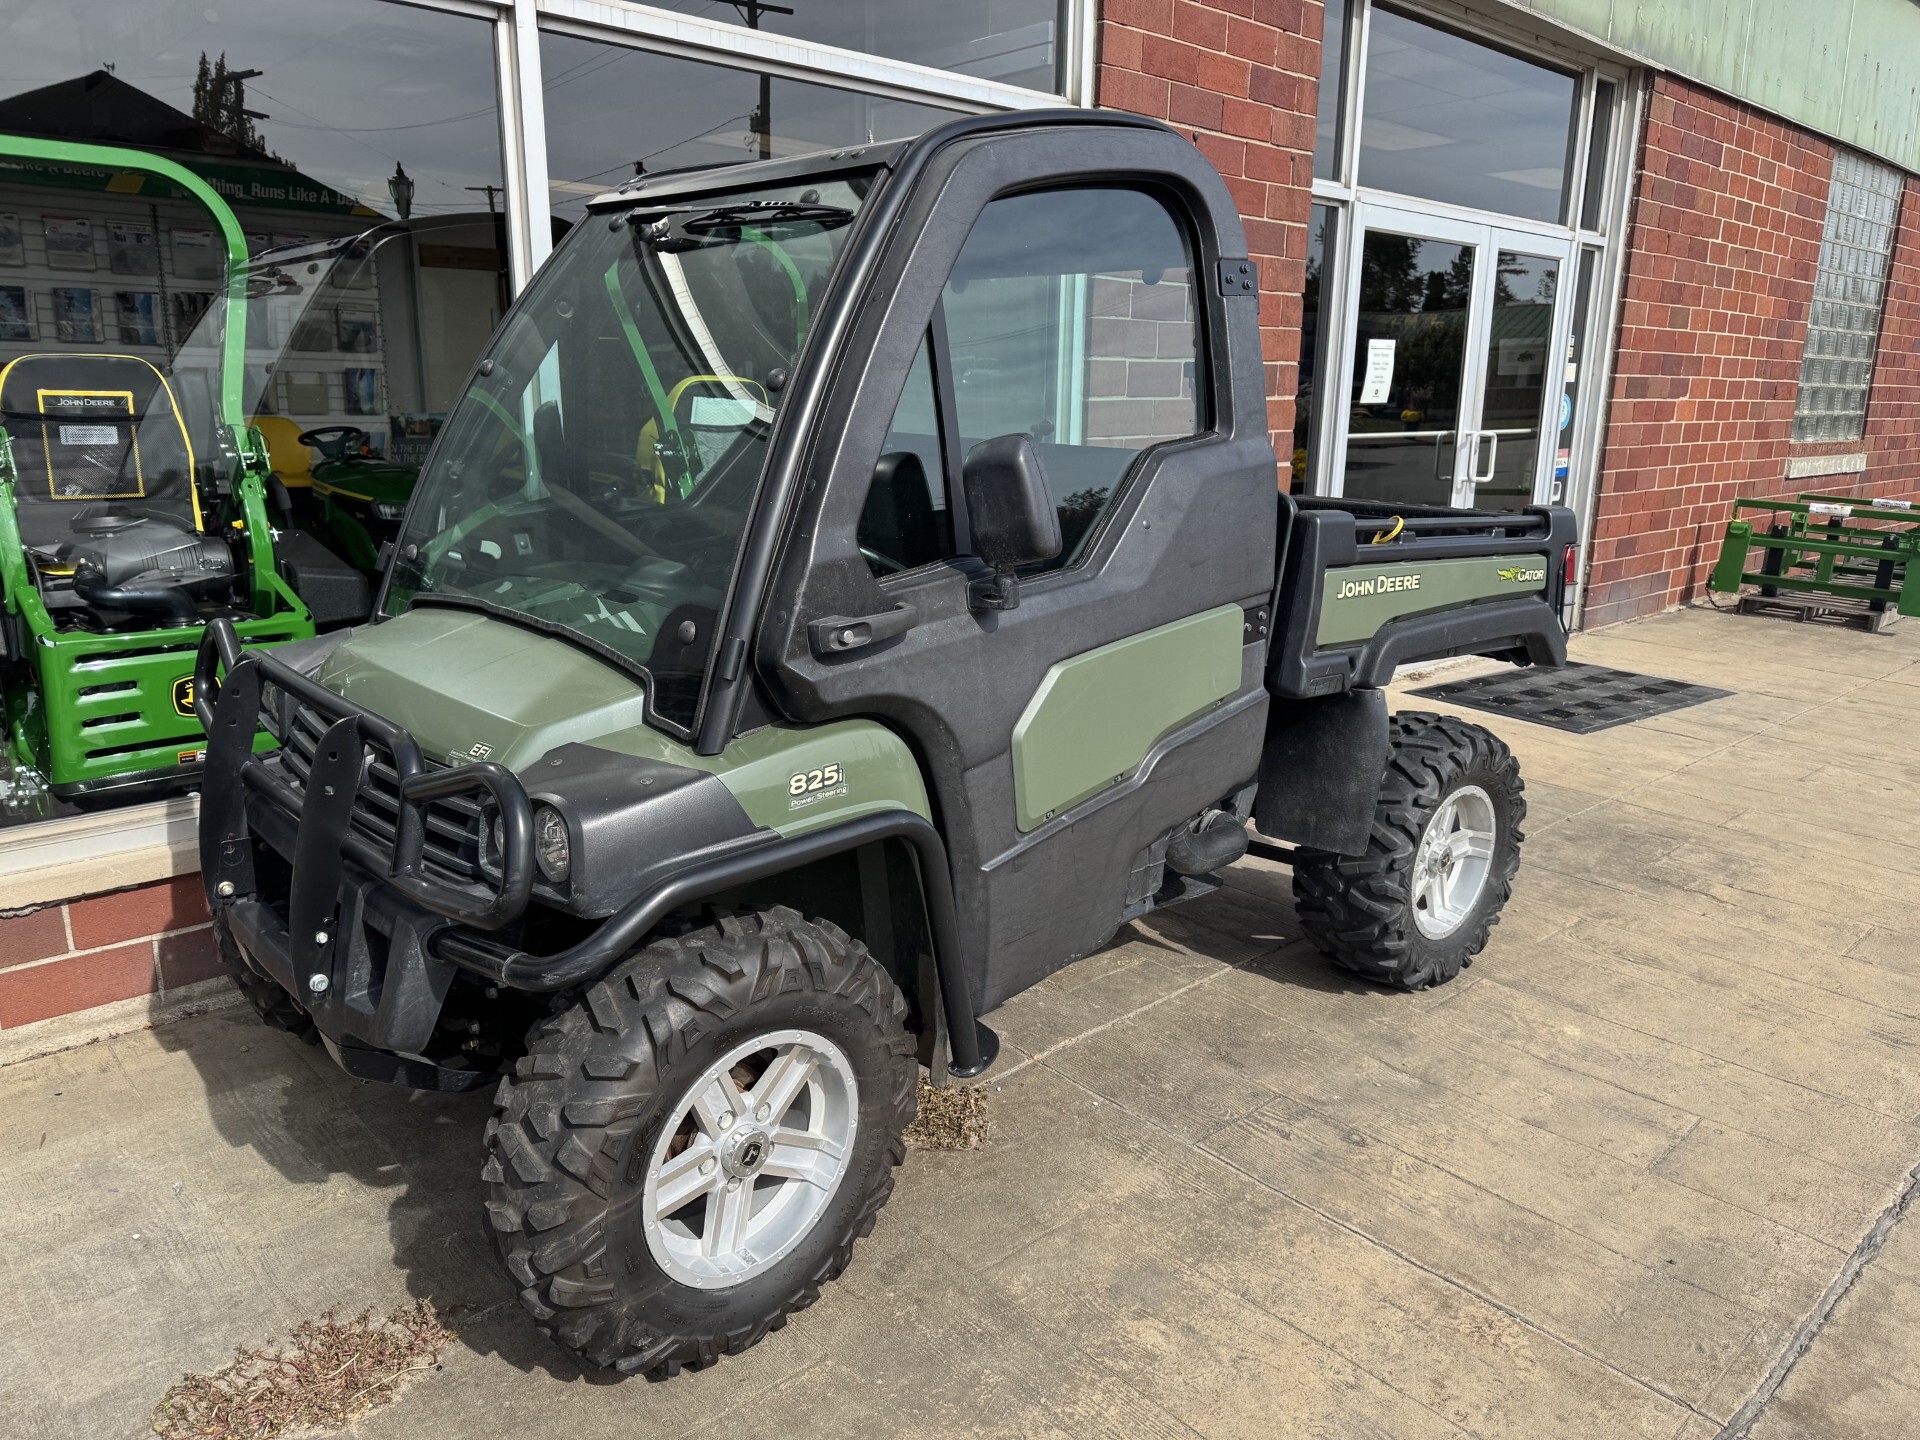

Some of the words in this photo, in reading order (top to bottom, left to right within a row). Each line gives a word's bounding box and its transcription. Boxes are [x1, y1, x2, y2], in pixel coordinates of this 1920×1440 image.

[251, 182, 286, 200] Runs
[288, 186, 317, 203] Like
[320, 189, 330, 204] A
[57, 398, 83, 406] JOHN
[84, 398, 115, 406] DEERE
[1517, 568, 1545, 582] GATOR
[1337, 579, 1375, 600] JOHN
[1377, 575, 1421, 594] DEERE
[469, 743, 492, 760] EFI
[789, 764, 843, 795] 825i
[790, 796, 815, 807] Power
[816, 786, 847, 799] Steering
